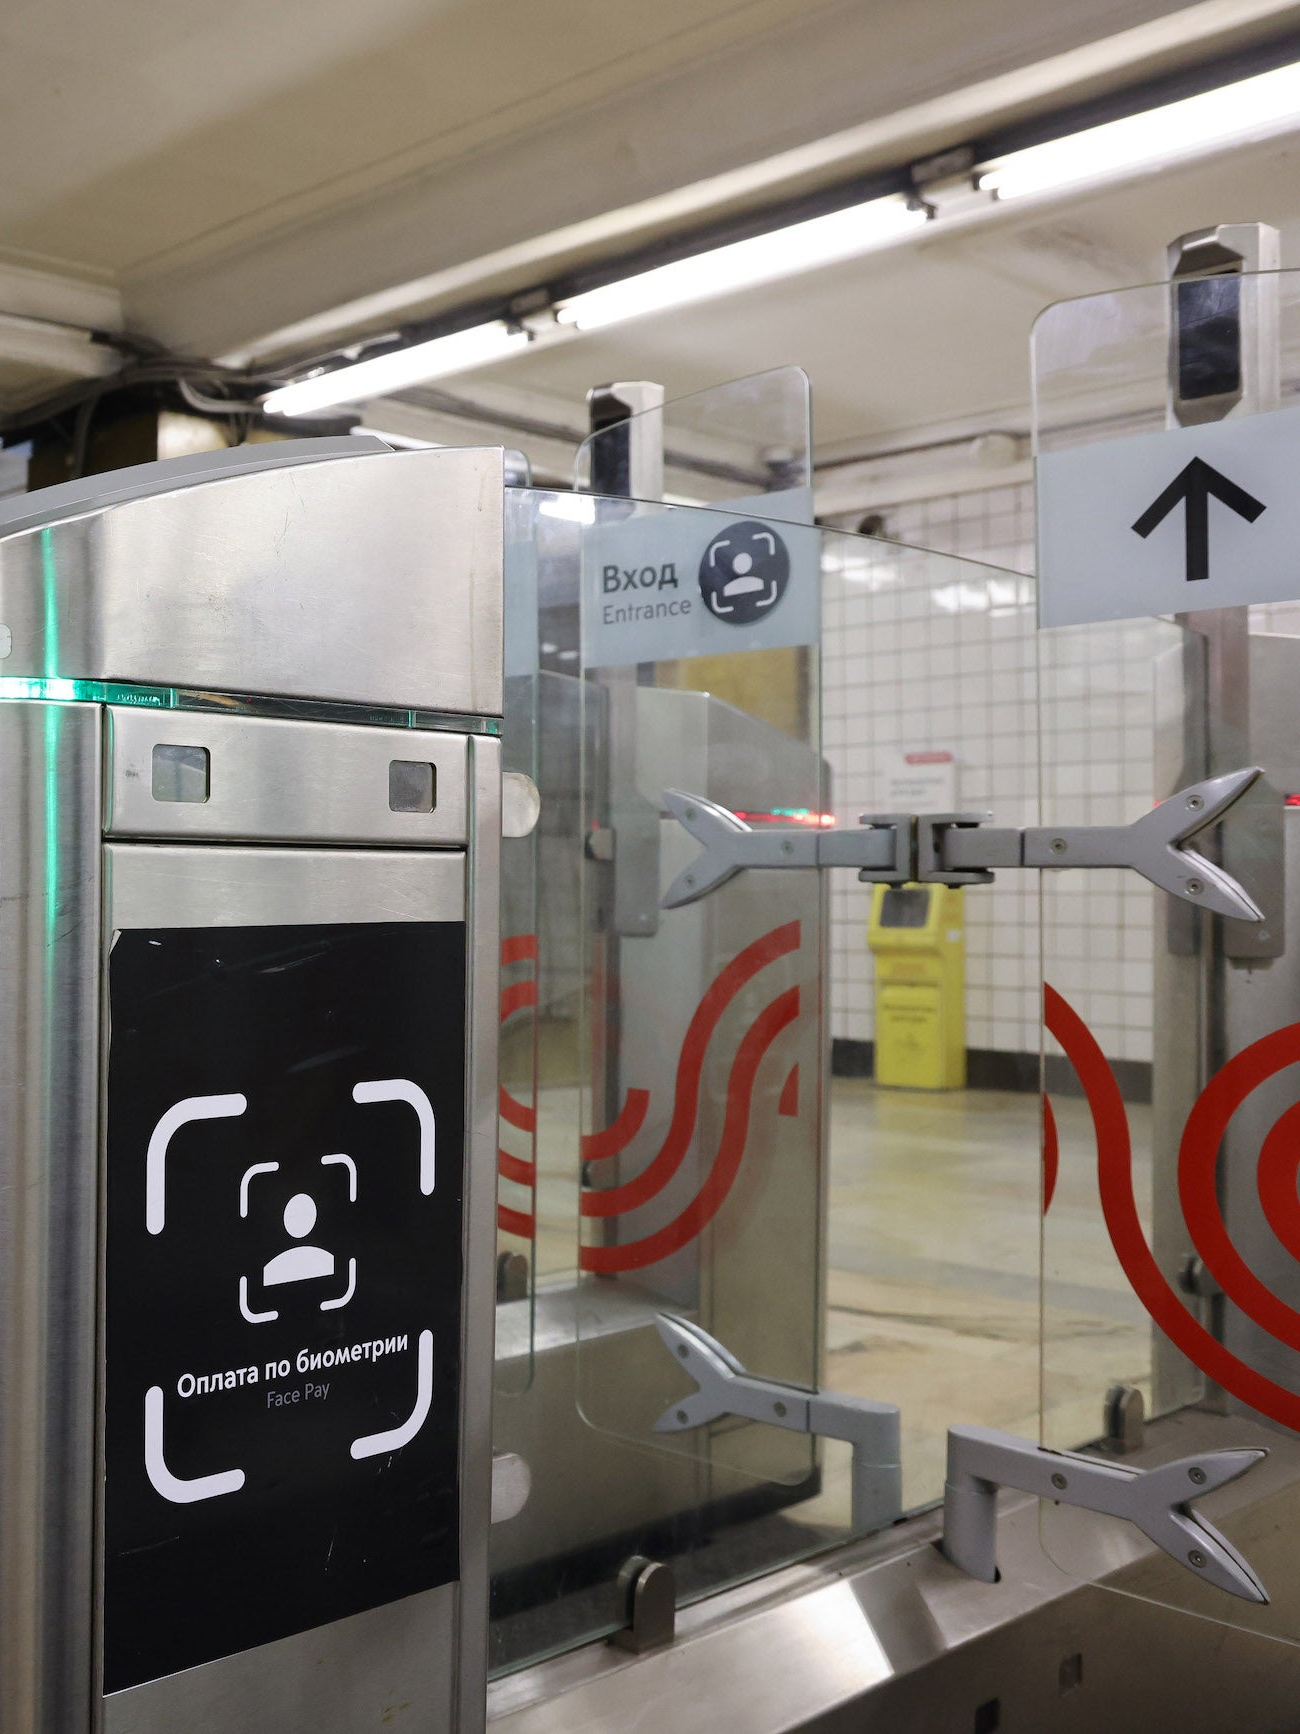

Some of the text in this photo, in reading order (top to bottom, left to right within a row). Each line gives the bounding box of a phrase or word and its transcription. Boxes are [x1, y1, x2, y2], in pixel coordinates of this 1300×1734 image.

[602, 563, 679, 593] Вход
[602, 599, 692, 625] Entrance
[177, 1334, 409, 1398] Оплата по биометрии
[266, 1382, 331, 1408] Face Pay
